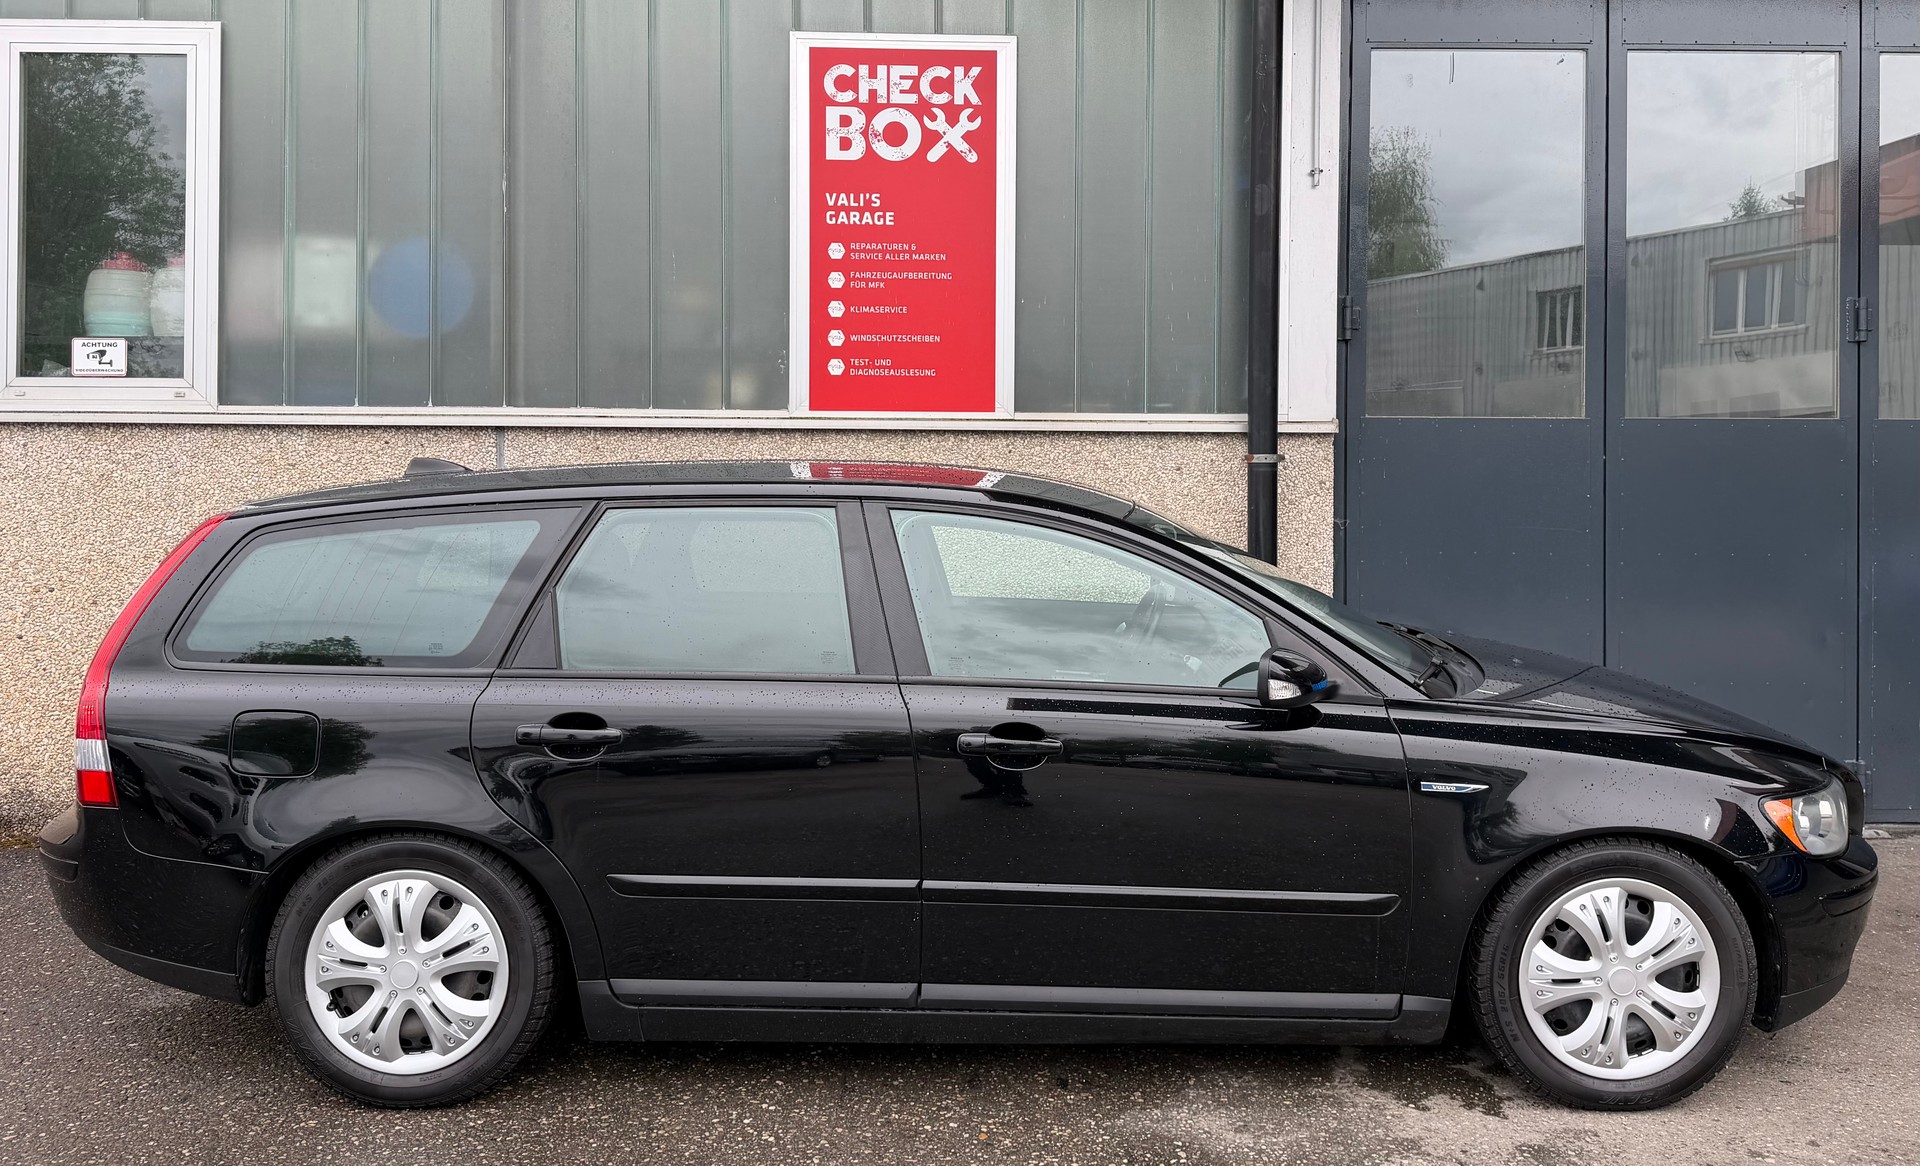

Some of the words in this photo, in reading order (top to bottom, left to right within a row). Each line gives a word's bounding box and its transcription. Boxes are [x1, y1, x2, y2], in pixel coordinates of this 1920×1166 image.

[823, 63, 983, 106] CHECK
[825, 105, 982, 163] BOX
[825, 192, 881, 207] VALI'S
[825, 211, 895, 226] GARAGE
[850, 242, 909, 251] REPARATUREN
[911, 243, 917, 251] &
[850, 252, 883, 260] SERVICE
[885, 253, 910, 261] ALLER
[912, 253, 946, 261] MARKEN
[850, 271, 953, 280] FAHRZEUGAUFBEREITUNG
[850, 281, 867, 289] FÜR
[868, 281, 886, 289] MFK
[850, 305, 908, 314] KLIMASERVICE
[850, 334, 941, 342] WINDSCHUTZSCHEIBEN
[850, 358, 872, 366] TEST-
[874, 358, 892, 366] UND
[849, 368, 936, 377] DIAGNOSEAUSLESUNG
